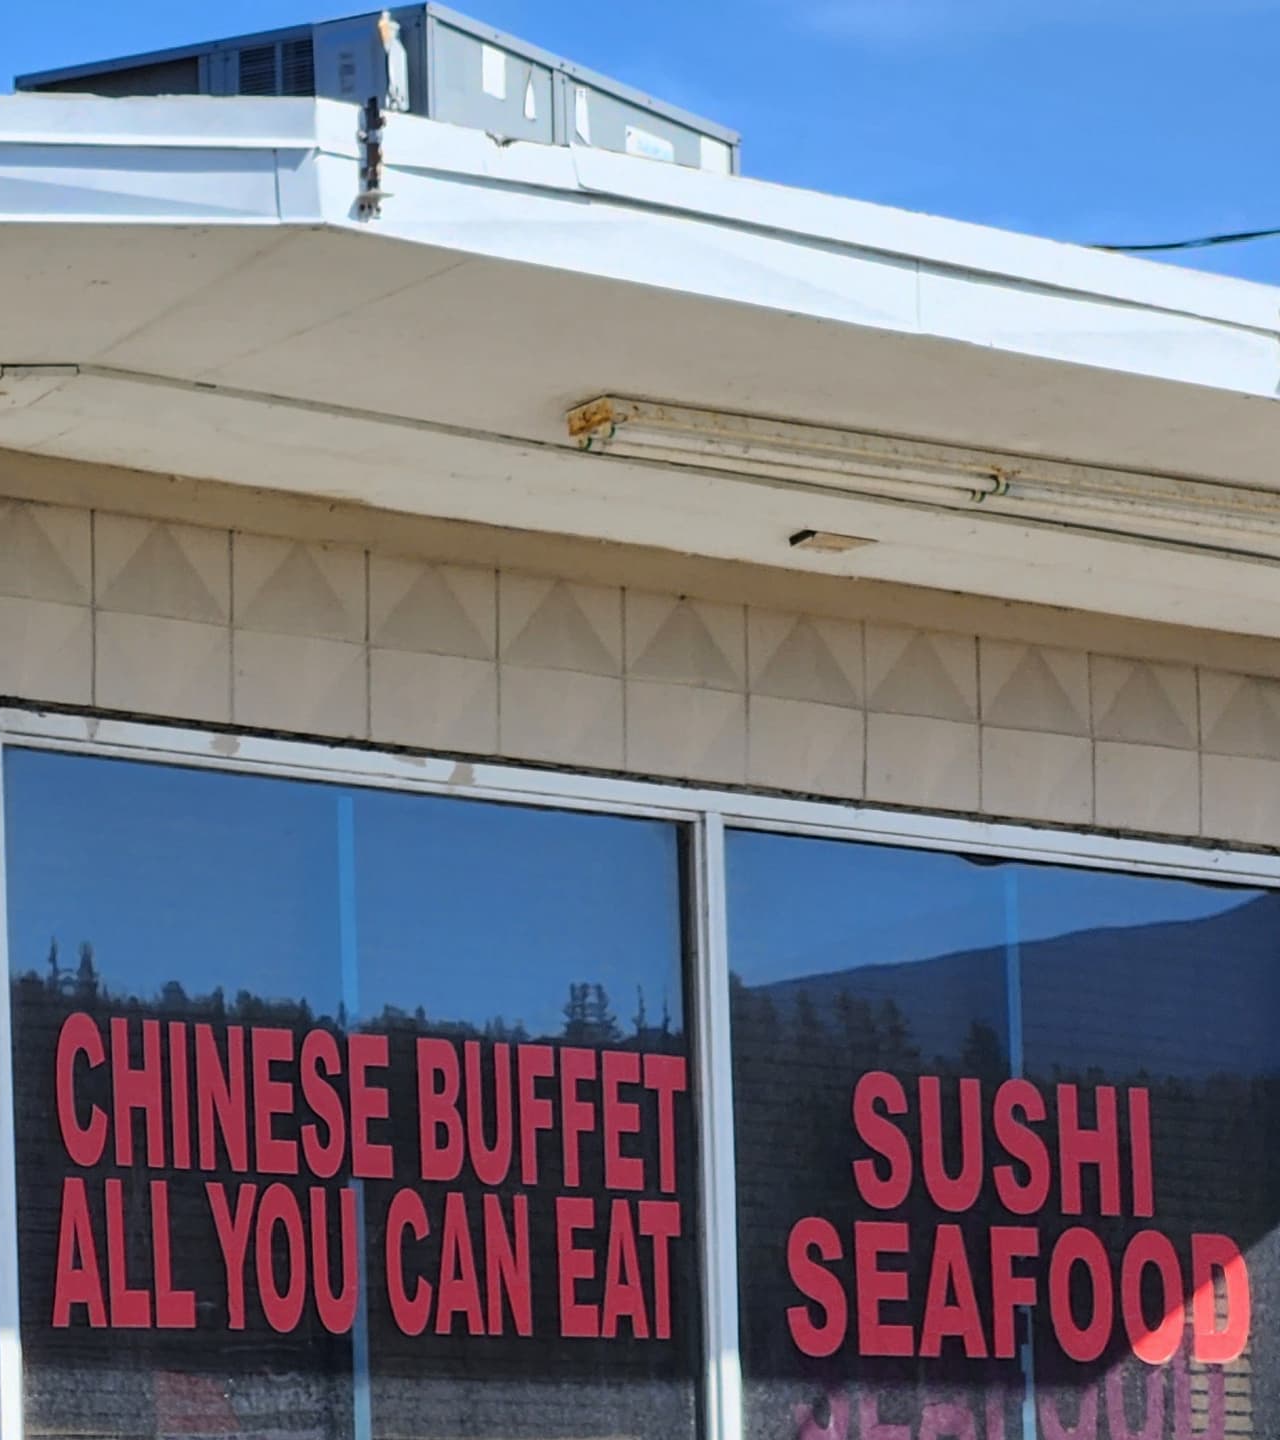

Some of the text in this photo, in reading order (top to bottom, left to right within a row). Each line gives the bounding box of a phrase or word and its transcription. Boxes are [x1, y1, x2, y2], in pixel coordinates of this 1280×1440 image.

[56, 1013, 687, 1193] CHINESE BUFFET
[852, 1071, 1155, 1218] SUSHI
[52, 1177, 681, 1339] ALL YOU CAN EAT
[786, 1216, 1252, 1364] SEAFOOD
